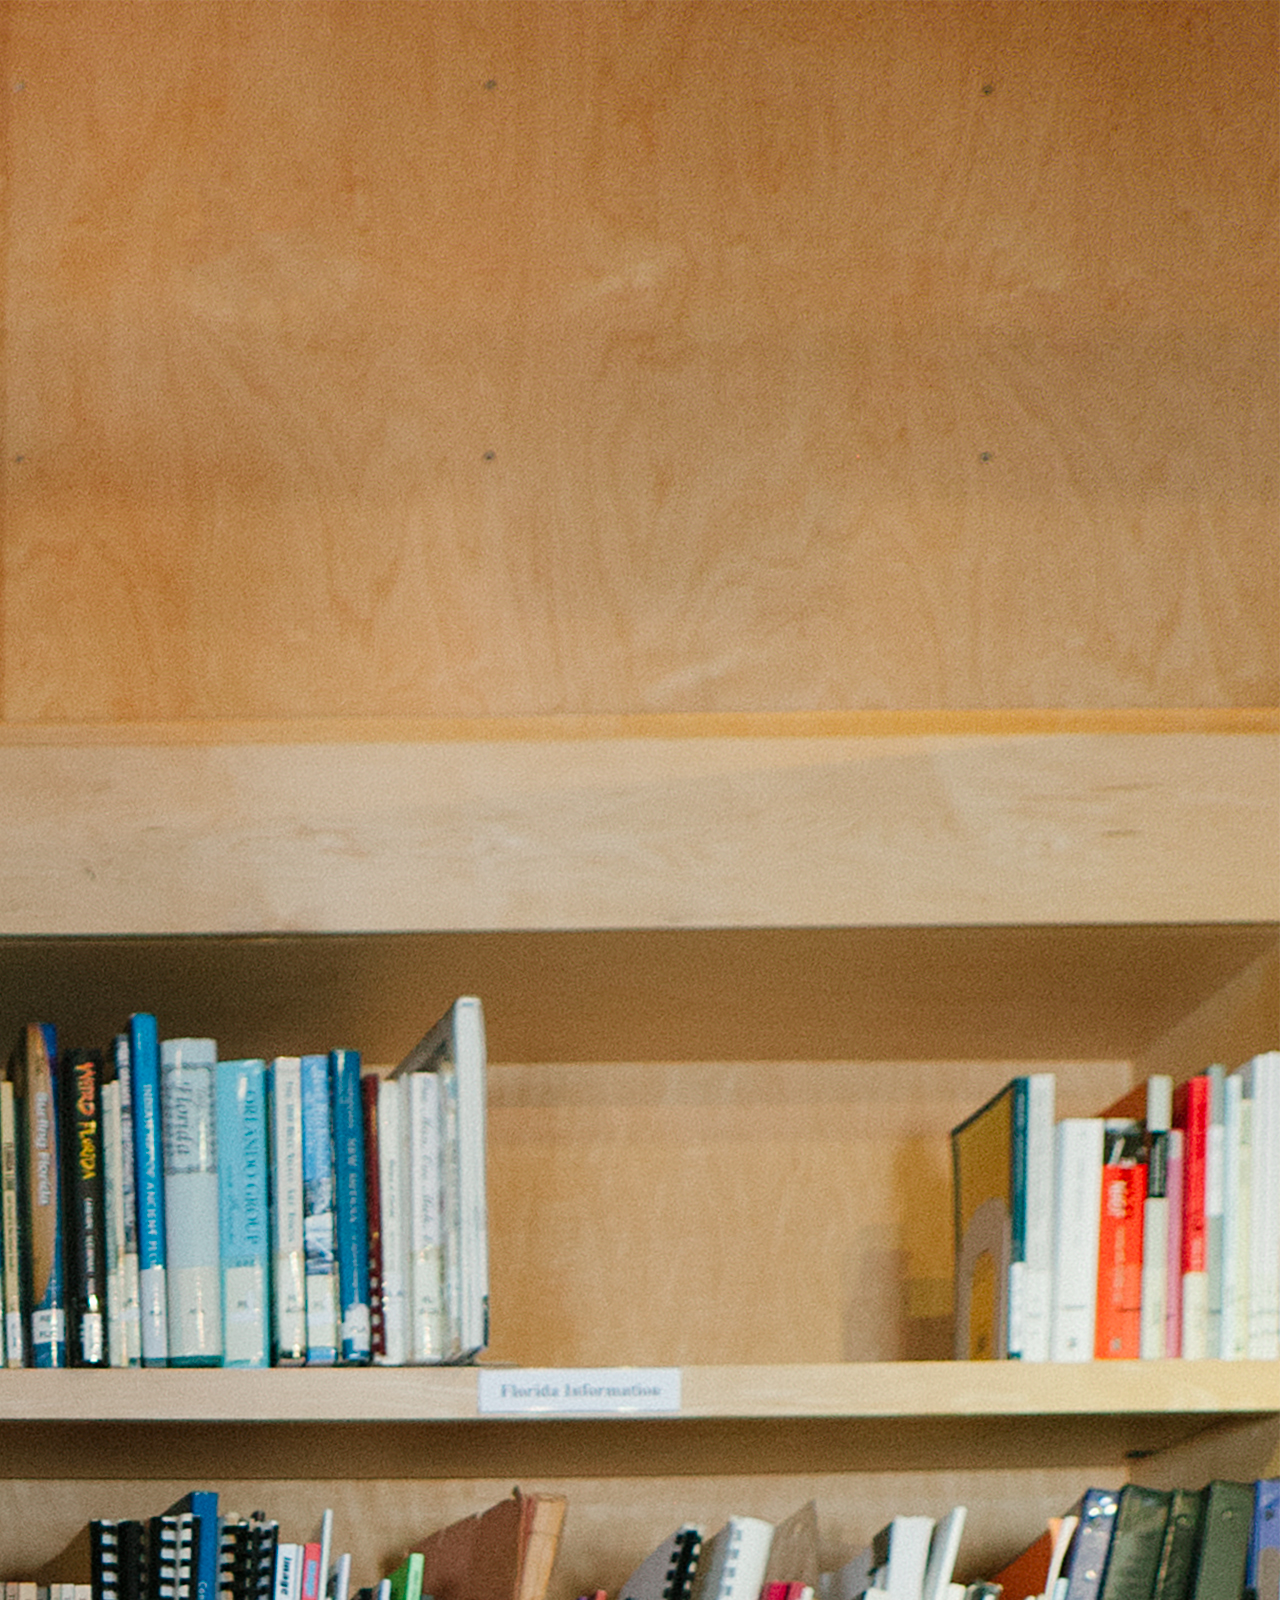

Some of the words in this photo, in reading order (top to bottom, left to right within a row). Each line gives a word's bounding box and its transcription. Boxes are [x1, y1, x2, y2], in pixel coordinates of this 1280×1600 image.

[77, 1119, 98, 1181] FLORIDA
[36, 1151, 52, 1206] Florida
[245, 1183, 260, 1246] GROUP
[500, 1383, 559, 1398] Florida
[564, 1383, 661, 1398] Information
[280, 1556, 293, 1596] image
